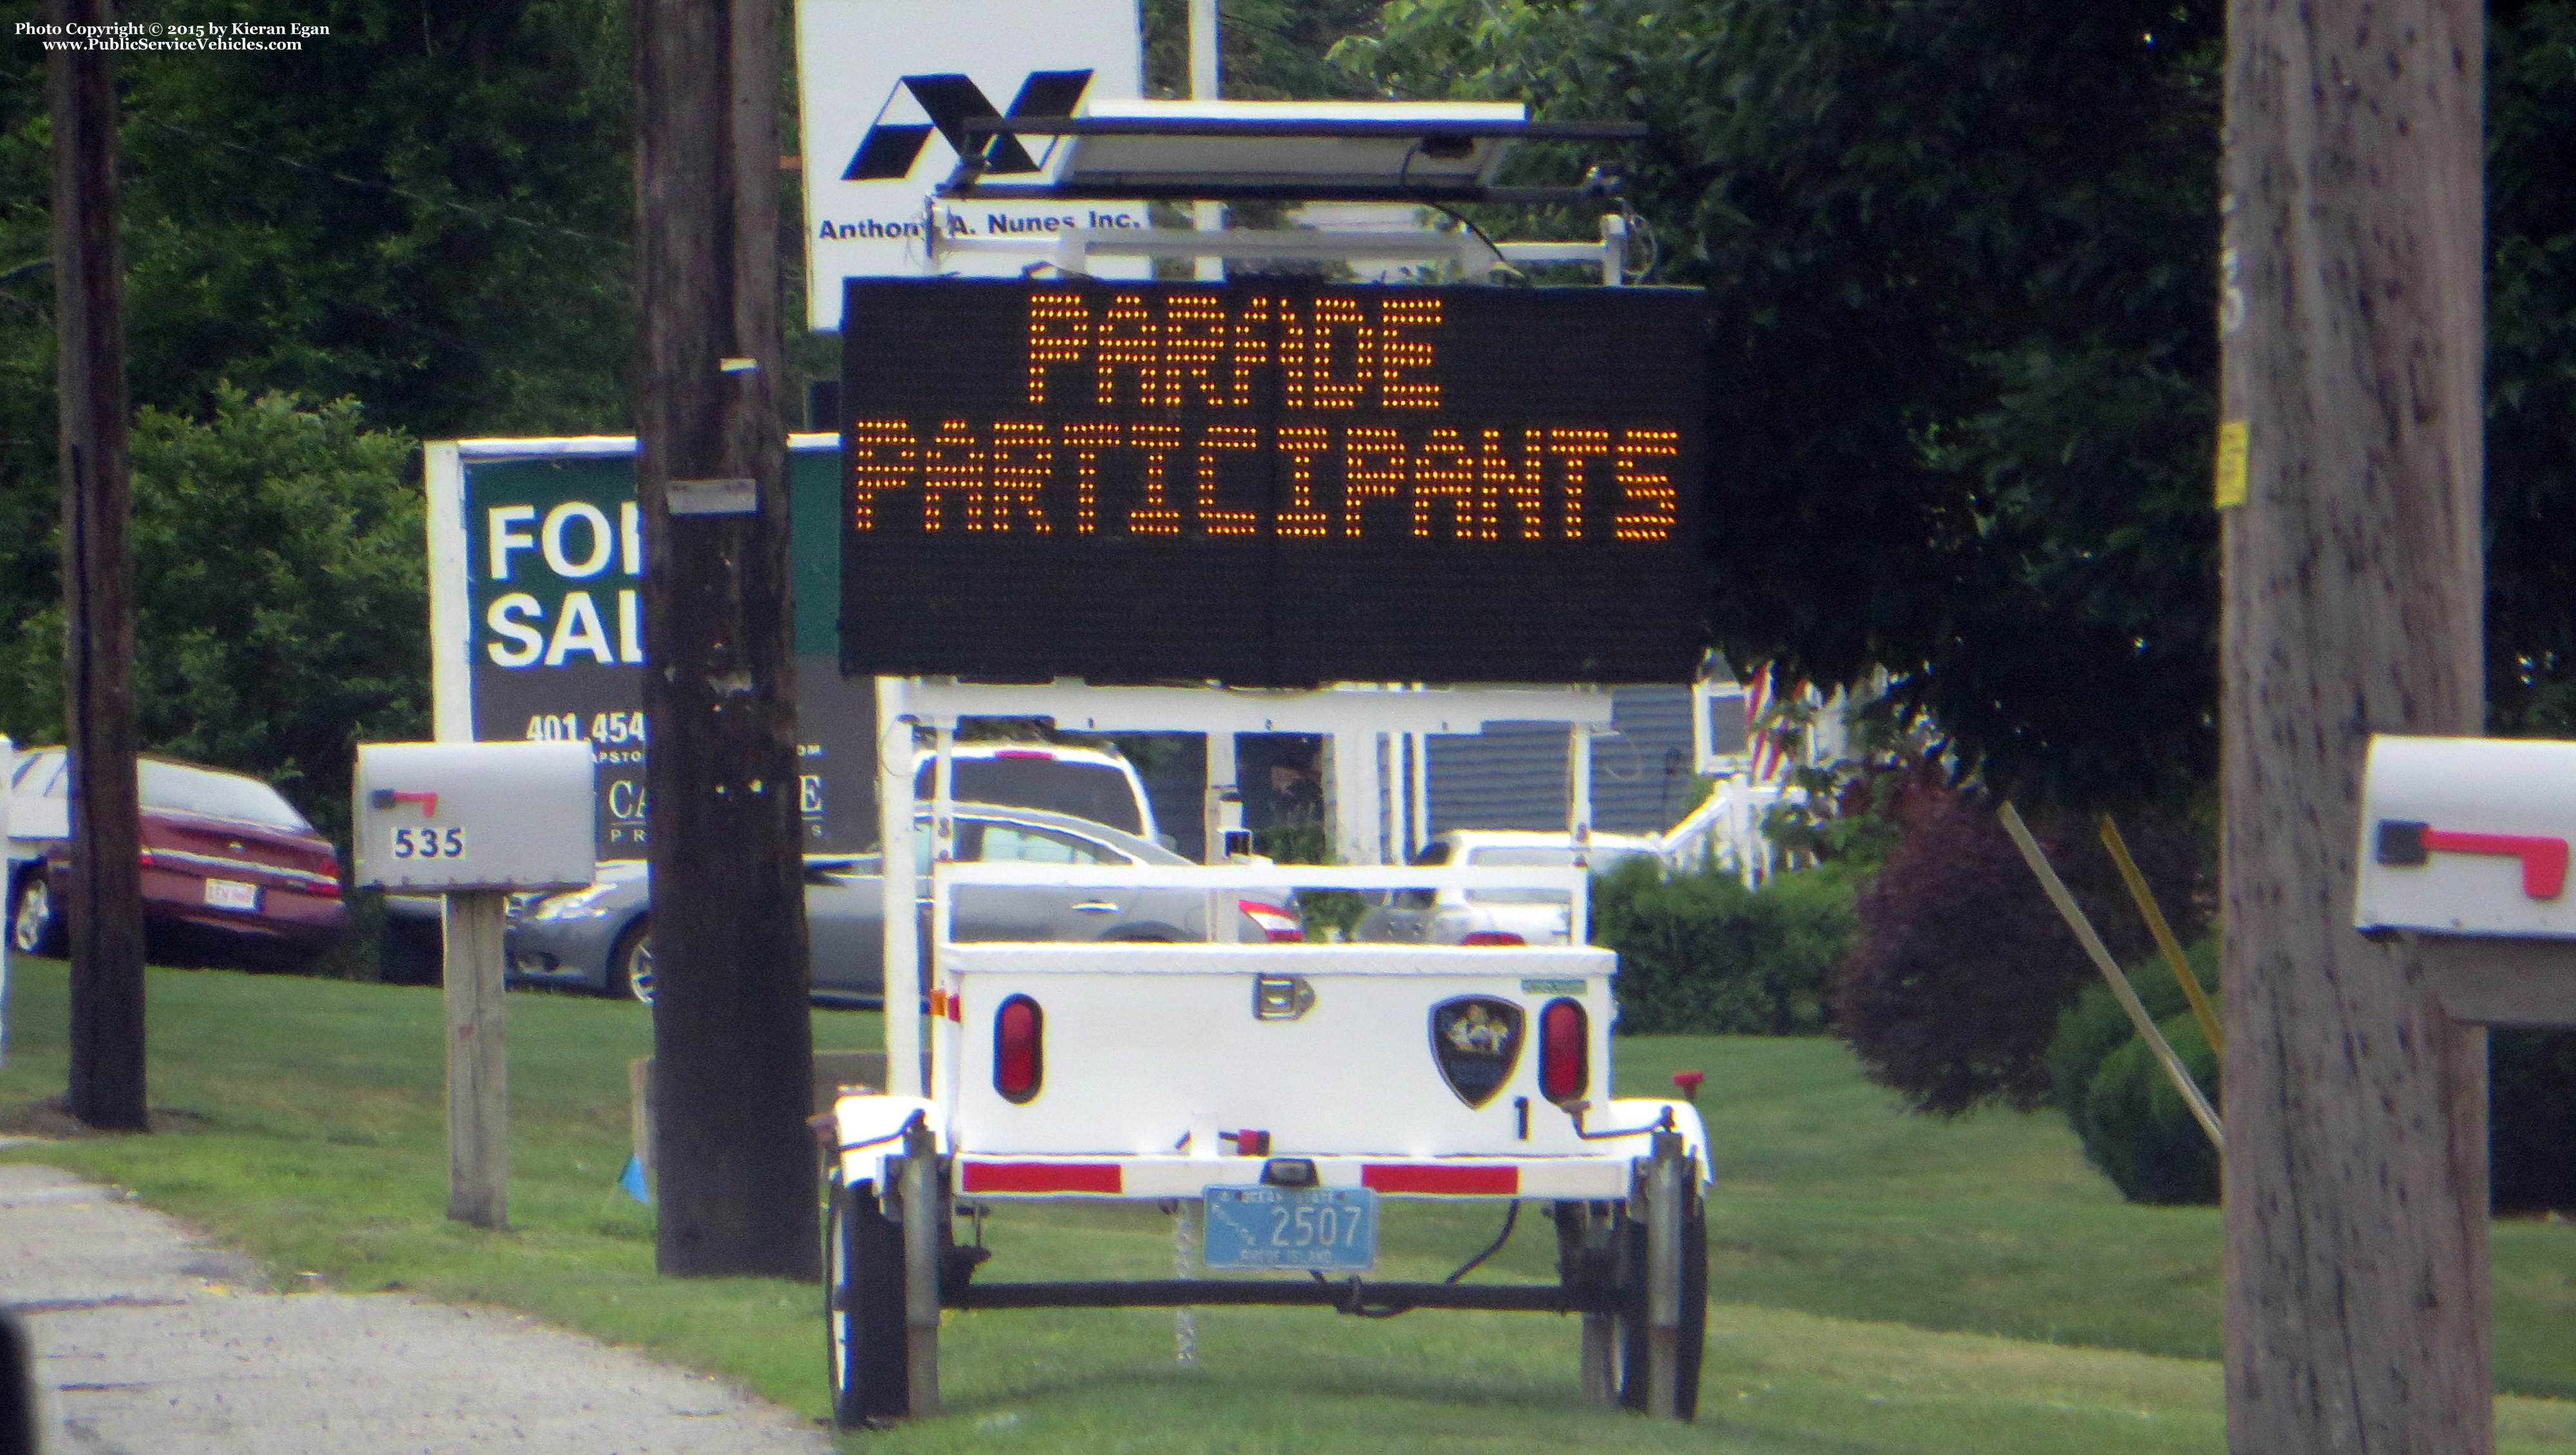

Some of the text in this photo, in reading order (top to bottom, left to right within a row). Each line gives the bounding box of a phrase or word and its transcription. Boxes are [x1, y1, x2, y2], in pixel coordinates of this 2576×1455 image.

[987, 213, 1075, 234] Nunes
[1088, 210, 1140, 228] Inc.
[1030, 296, 1441, 406] PARADE
[857, 419, 1678, 538] PARTICIPANTS
[395, 827, 463, 858] 535
[1514, 1096, 1528, 1140] 1
[1271, 1206, 1361, 1247] 2507
